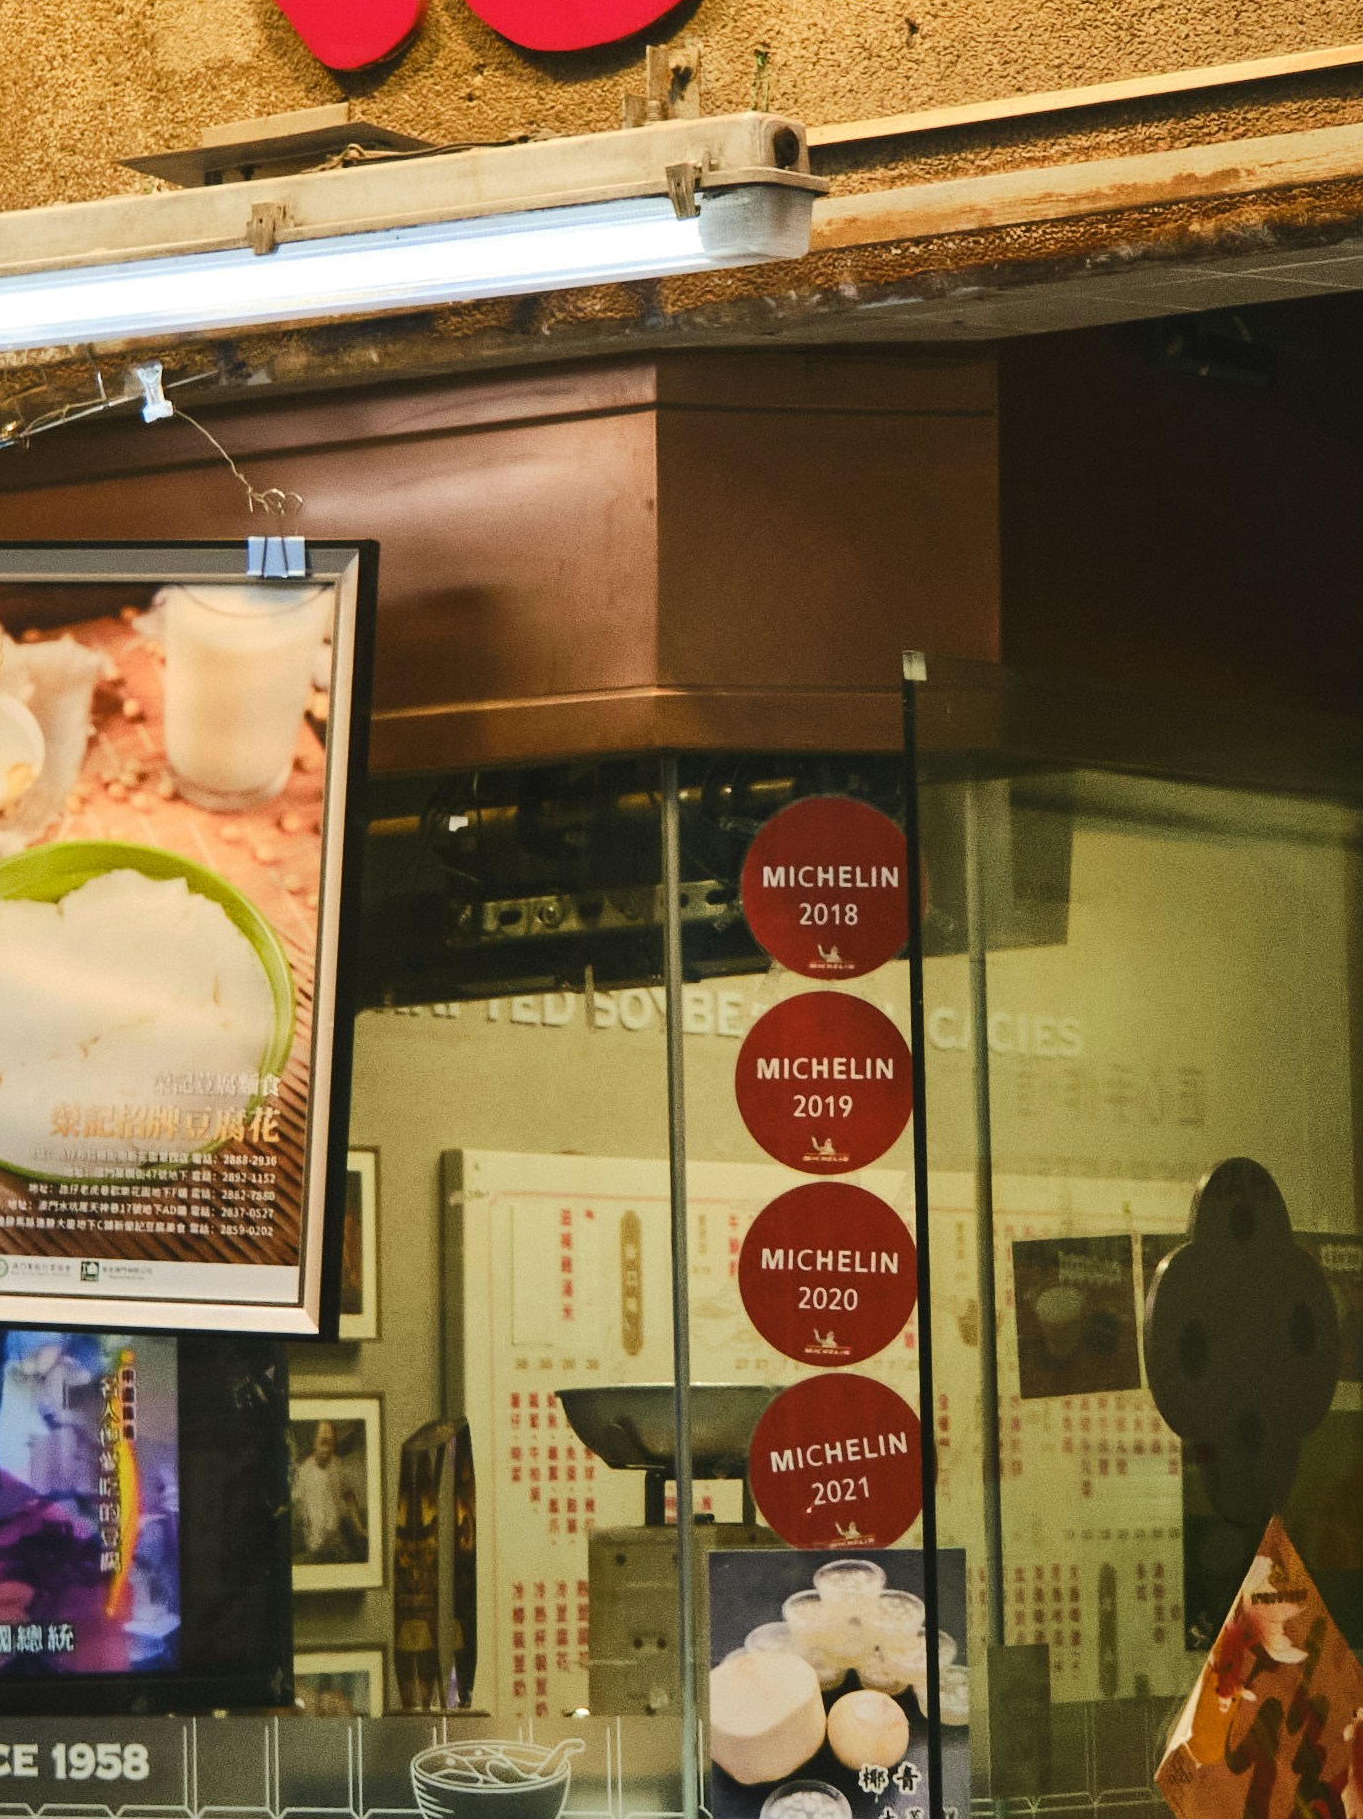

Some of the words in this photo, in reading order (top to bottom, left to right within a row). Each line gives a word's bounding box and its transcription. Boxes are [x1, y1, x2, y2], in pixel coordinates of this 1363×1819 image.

[762, 866, 899, 888] MICHELIN
[799, 903, 858, 925] 2018
[756, 1057, 894, 1080] MICHELIN
[793, 1094, 853, 1118] 2019
[761, 1248, 899, 1274] MICHELIN
[798, 1286, 858, 1311] 2020
[770, 1431, 908, 1473] MICHELIN
[811, 1476, 869, 1505] 2021
[51, 1742, 150, 1780] 1958
[858, 1761, 922, 1794] 椰青
